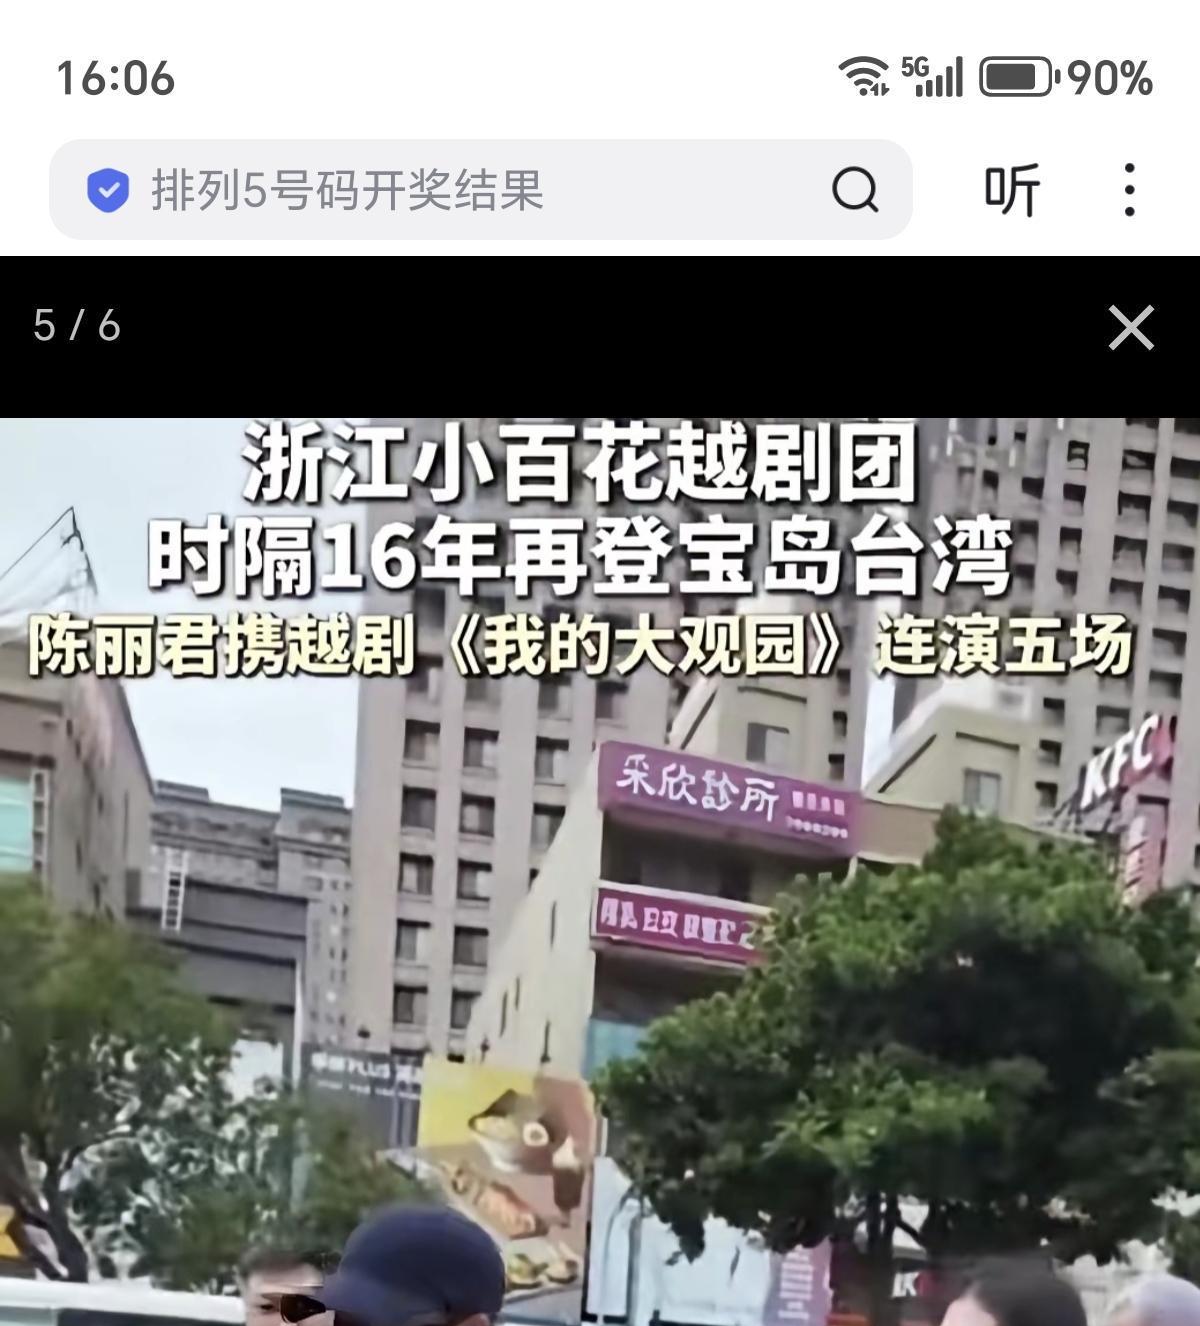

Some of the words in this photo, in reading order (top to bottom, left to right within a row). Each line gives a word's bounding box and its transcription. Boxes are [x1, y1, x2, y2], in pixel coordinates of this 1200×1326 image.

[58, 59, 175, 96] 16:06
[901, 55, 930, 78] 5G
[1067, 59, 1154, 96] 90%
[151, 167, 544, 211] 排列5号码开奖结果
[985, 162, 1041, 218] 听
[1080, 714, 1159, 810] KFC
[616, 753, 779, 822] 采欣診所
